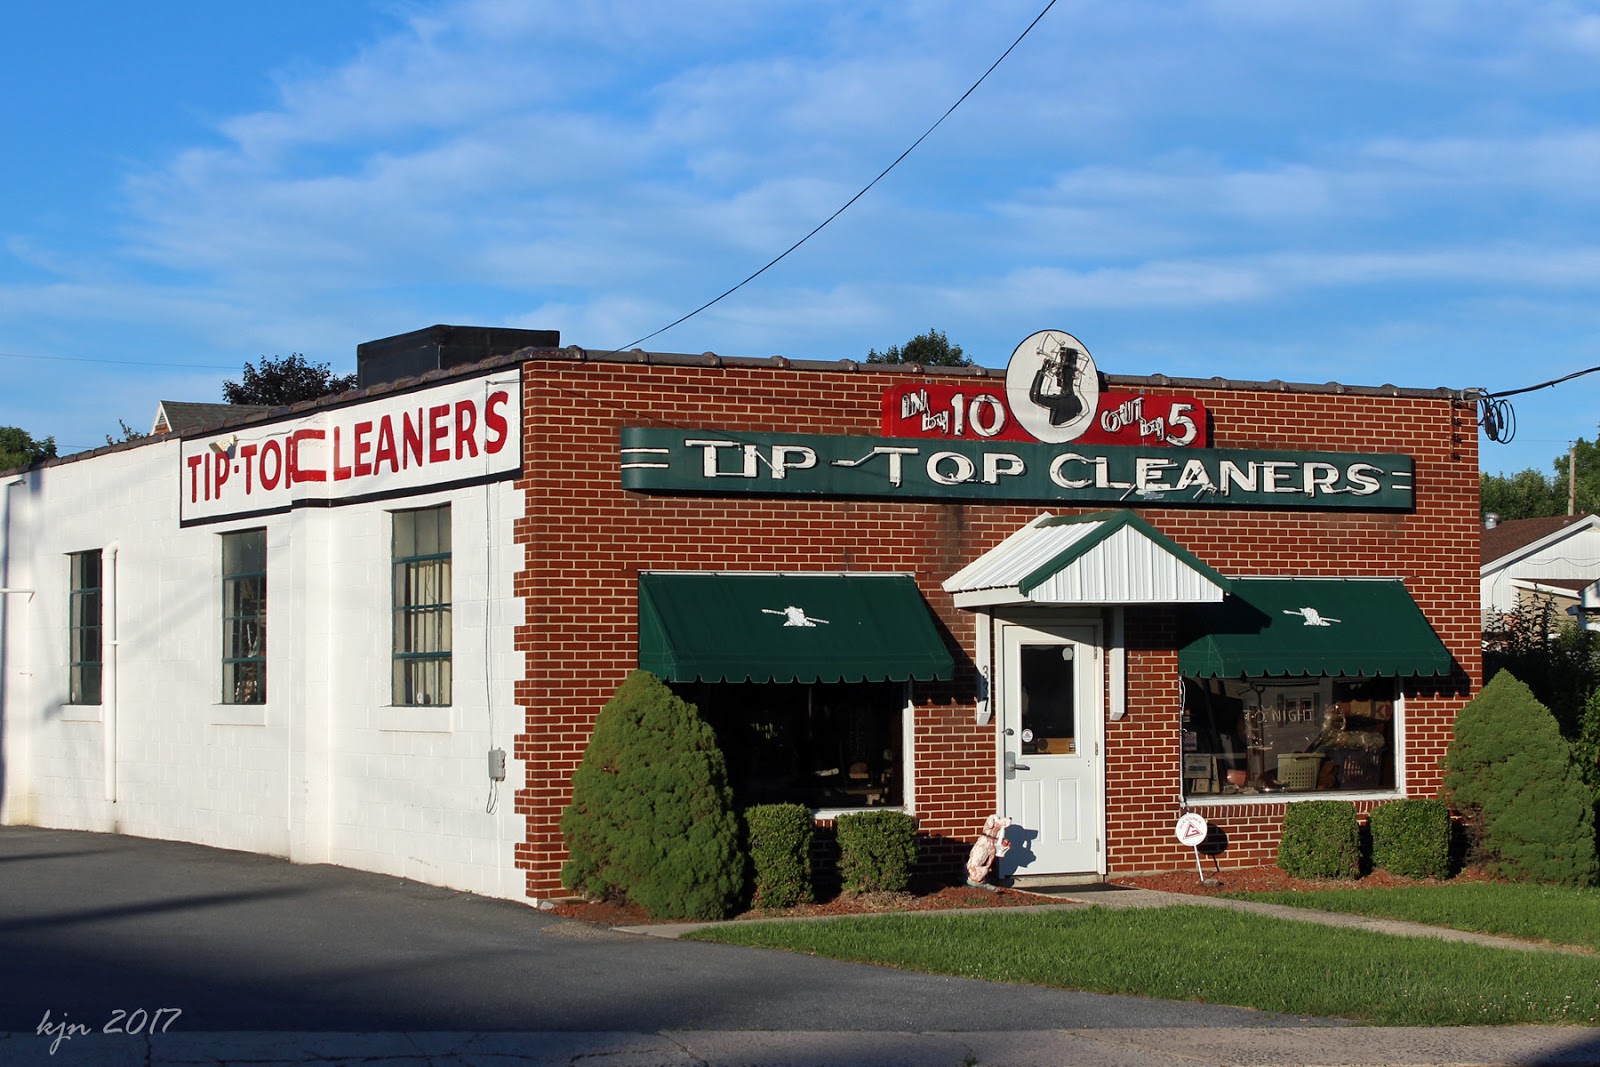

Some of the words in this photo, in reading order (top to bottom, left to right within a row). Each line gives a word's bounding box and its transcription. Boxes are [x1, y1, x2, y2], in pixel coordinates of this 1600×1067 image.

[291, 390, 509, 483] CLEANERS
[901, 389, 928, 419] IN
[922, 410, 949, 434] by
[951, 393, 1005, 437] 10
[1101, 397, 1143, 432] OUT
[1166, 403, 1197, 446] 5
[1049, 452, 1384, 500] CLEANERS
